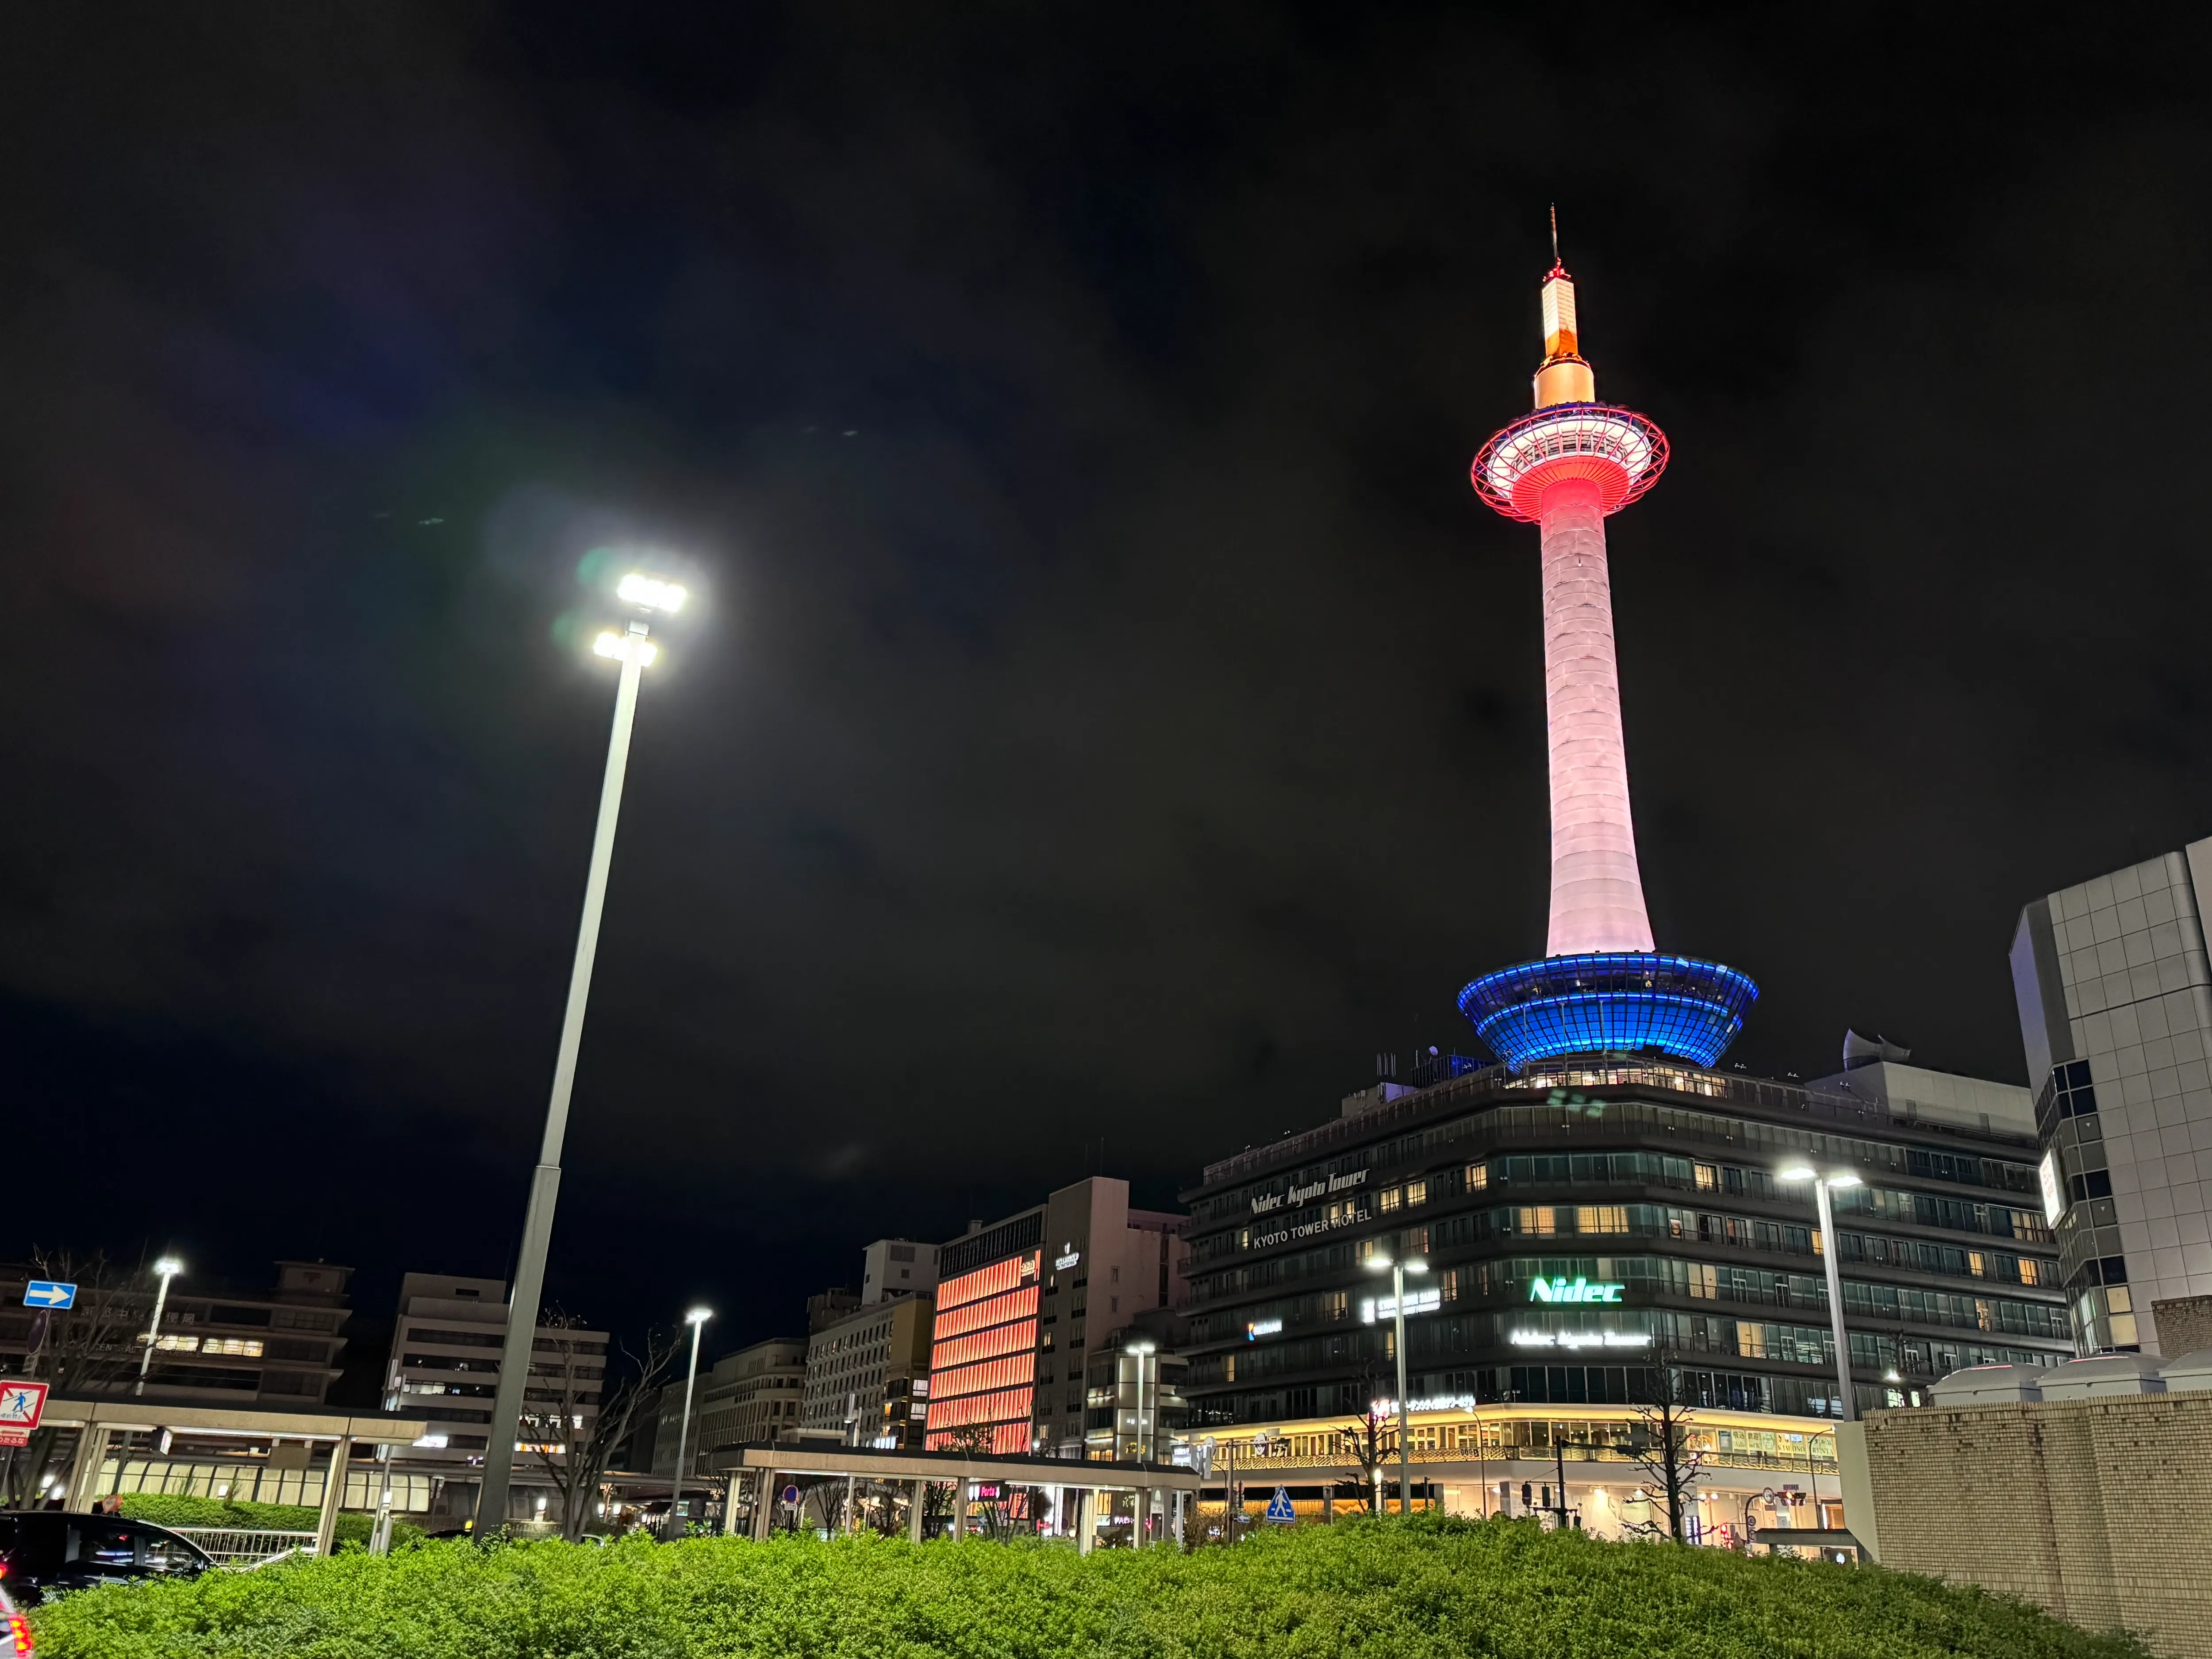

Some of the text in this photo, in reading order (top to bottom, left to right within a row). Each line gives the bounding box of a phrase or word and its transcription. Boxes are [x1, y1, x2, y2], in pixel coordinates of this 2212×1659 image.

[1250, 1169, 1370, 1215] Nidec Kyoto Tower
[1254, 1209, 1371, 1249] KYOTO TOWER HOTEL
[1530, 1278, 1625, 1302] Nidec
[96, 1343, 136, 1354] ENAL
[1778, 1444, 1805, 1452] KIMONO
[981, 1486, 995, 1497] Porta
